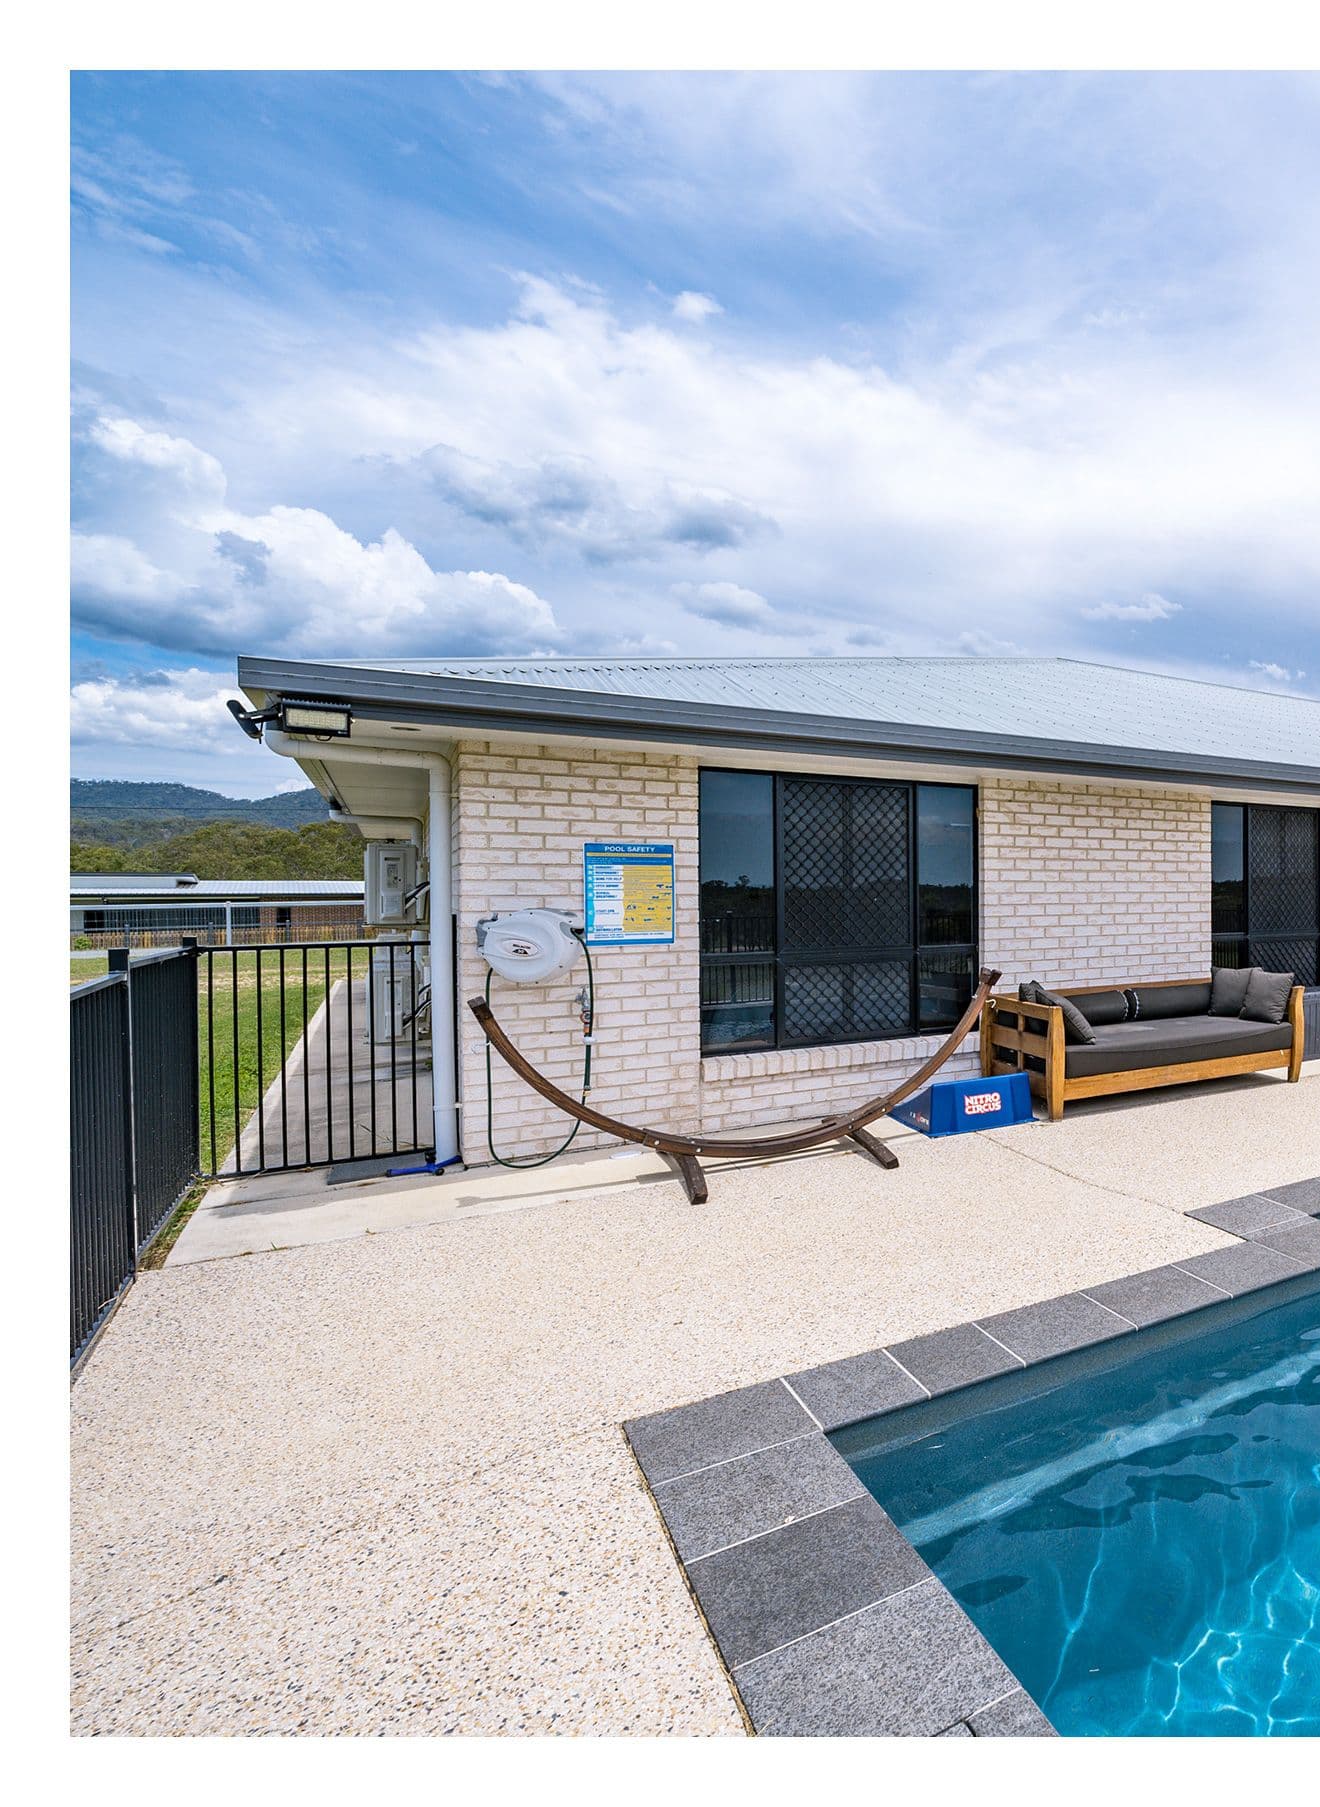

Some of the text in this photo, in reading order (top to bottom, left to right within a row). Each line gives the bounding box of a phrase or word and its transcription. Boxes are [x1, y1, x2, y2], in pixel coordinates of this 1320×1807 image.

[604, 845, 656, 853] POOL SAFETY
[964, 1092, 1001, 1106] NITRO
[965, 1101, 1001, 1115] CIRCUS
